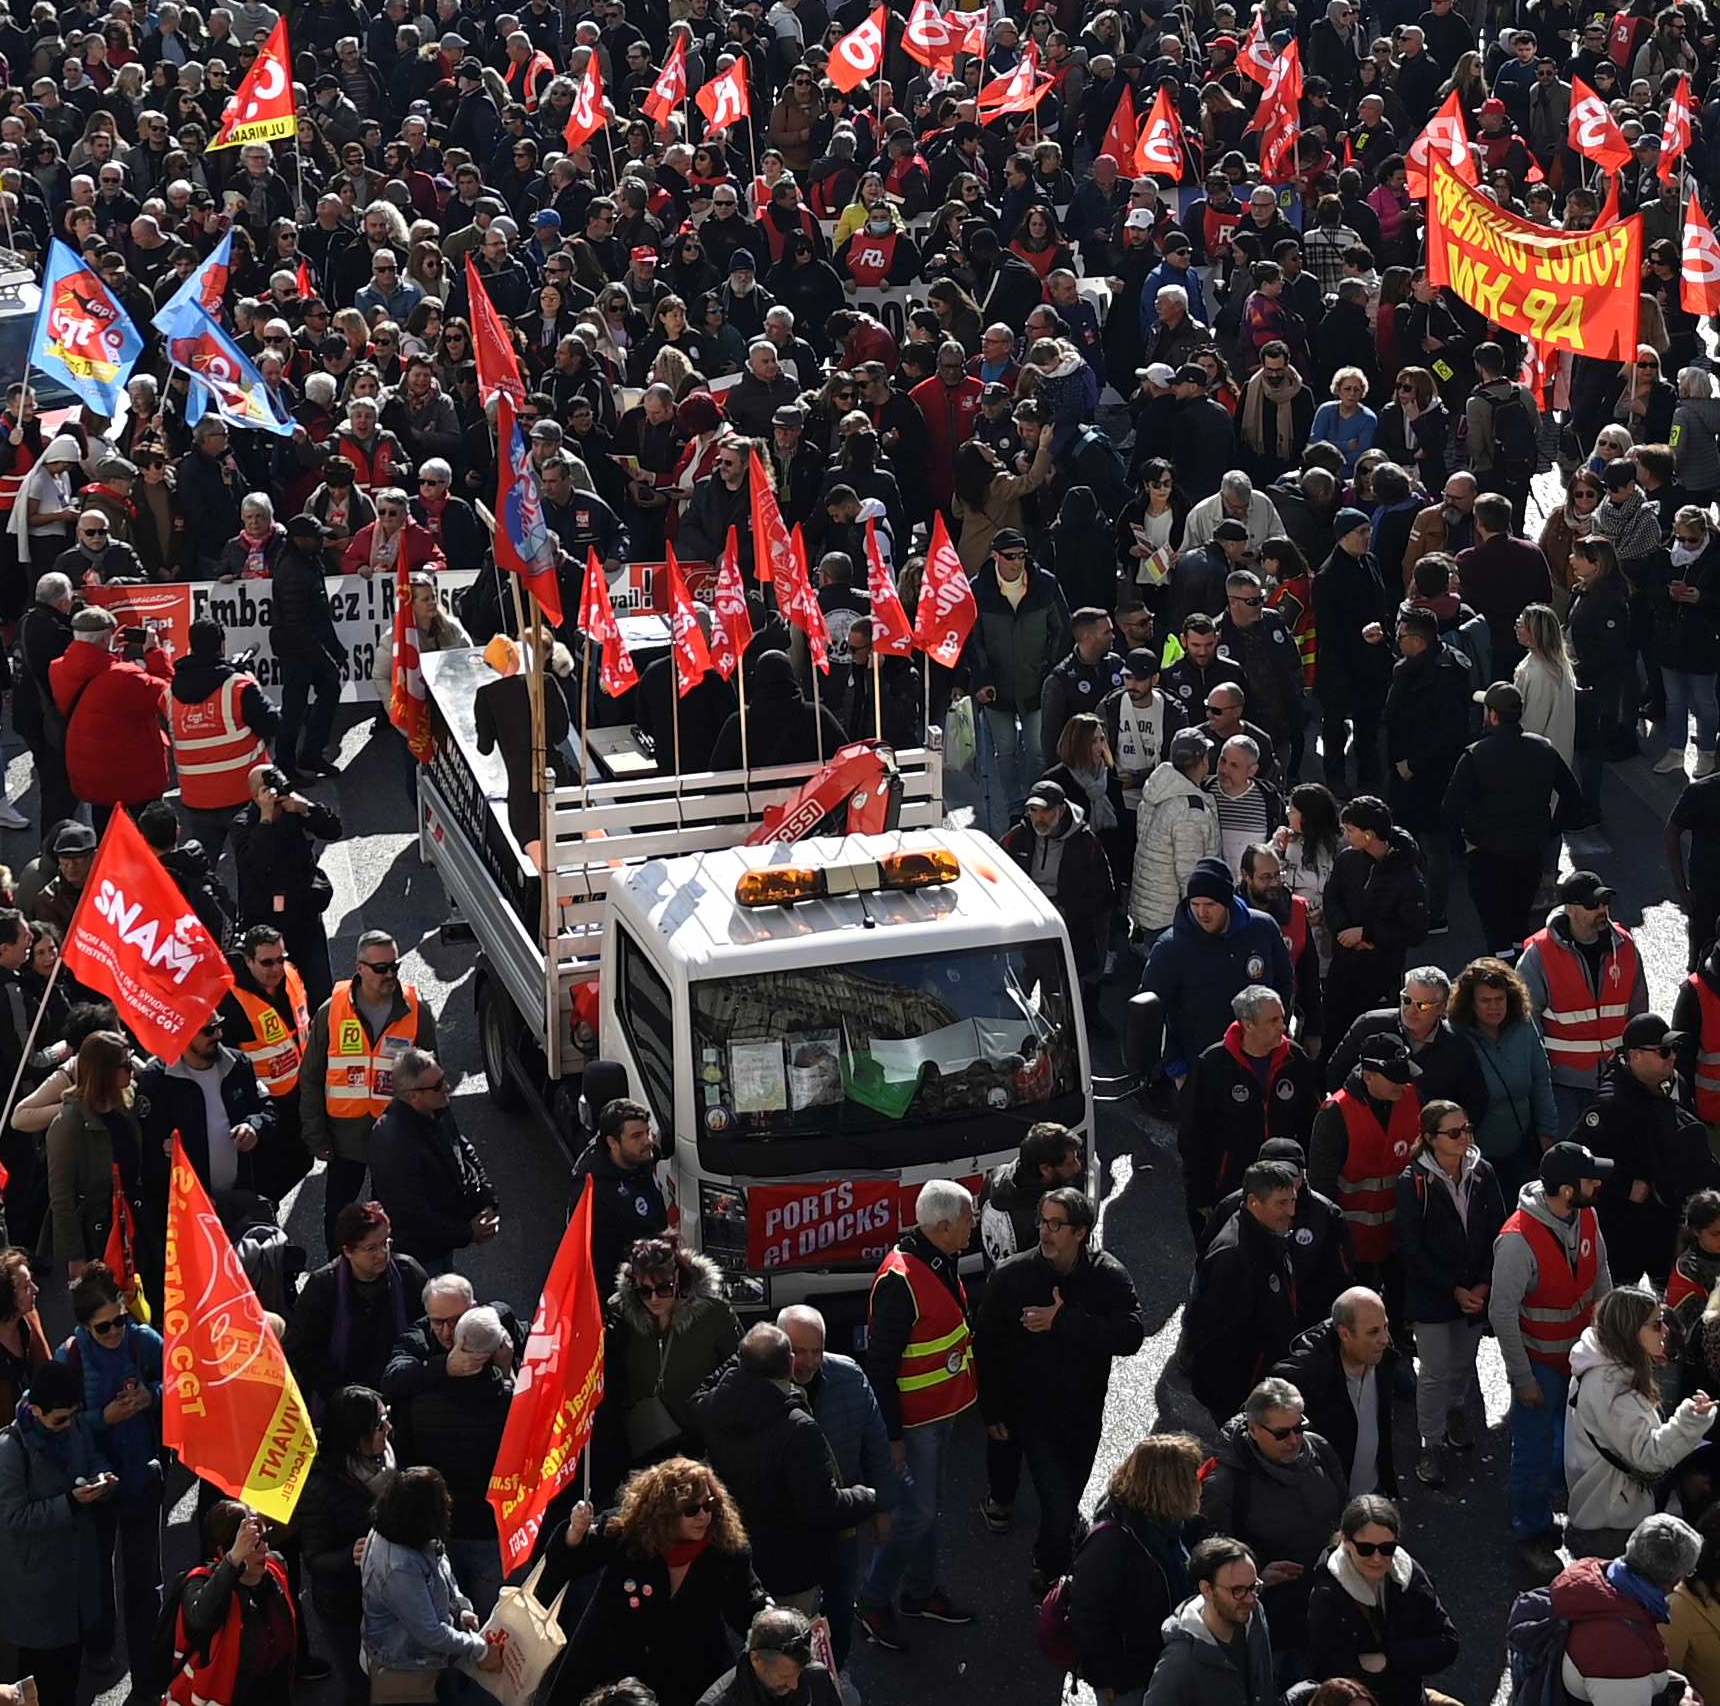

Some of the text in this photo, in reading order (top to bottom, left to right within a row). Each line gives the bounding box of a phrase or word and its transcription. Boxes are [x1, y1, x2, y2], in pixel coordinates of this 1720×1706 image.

[140, 614, 174, 634] Fapt
[93, 878, 200, 985] SNAM
[156, 1014, 181, 1035] CGT
[263, 1013, 281, 1037] FO
[343, 1025, 362, 1045] FO
[764, 1180, 854, 1238] PORTS
[762, 1197, 890, 1270] et DOCKS
[169, 1344, 207, 1419] CGT
